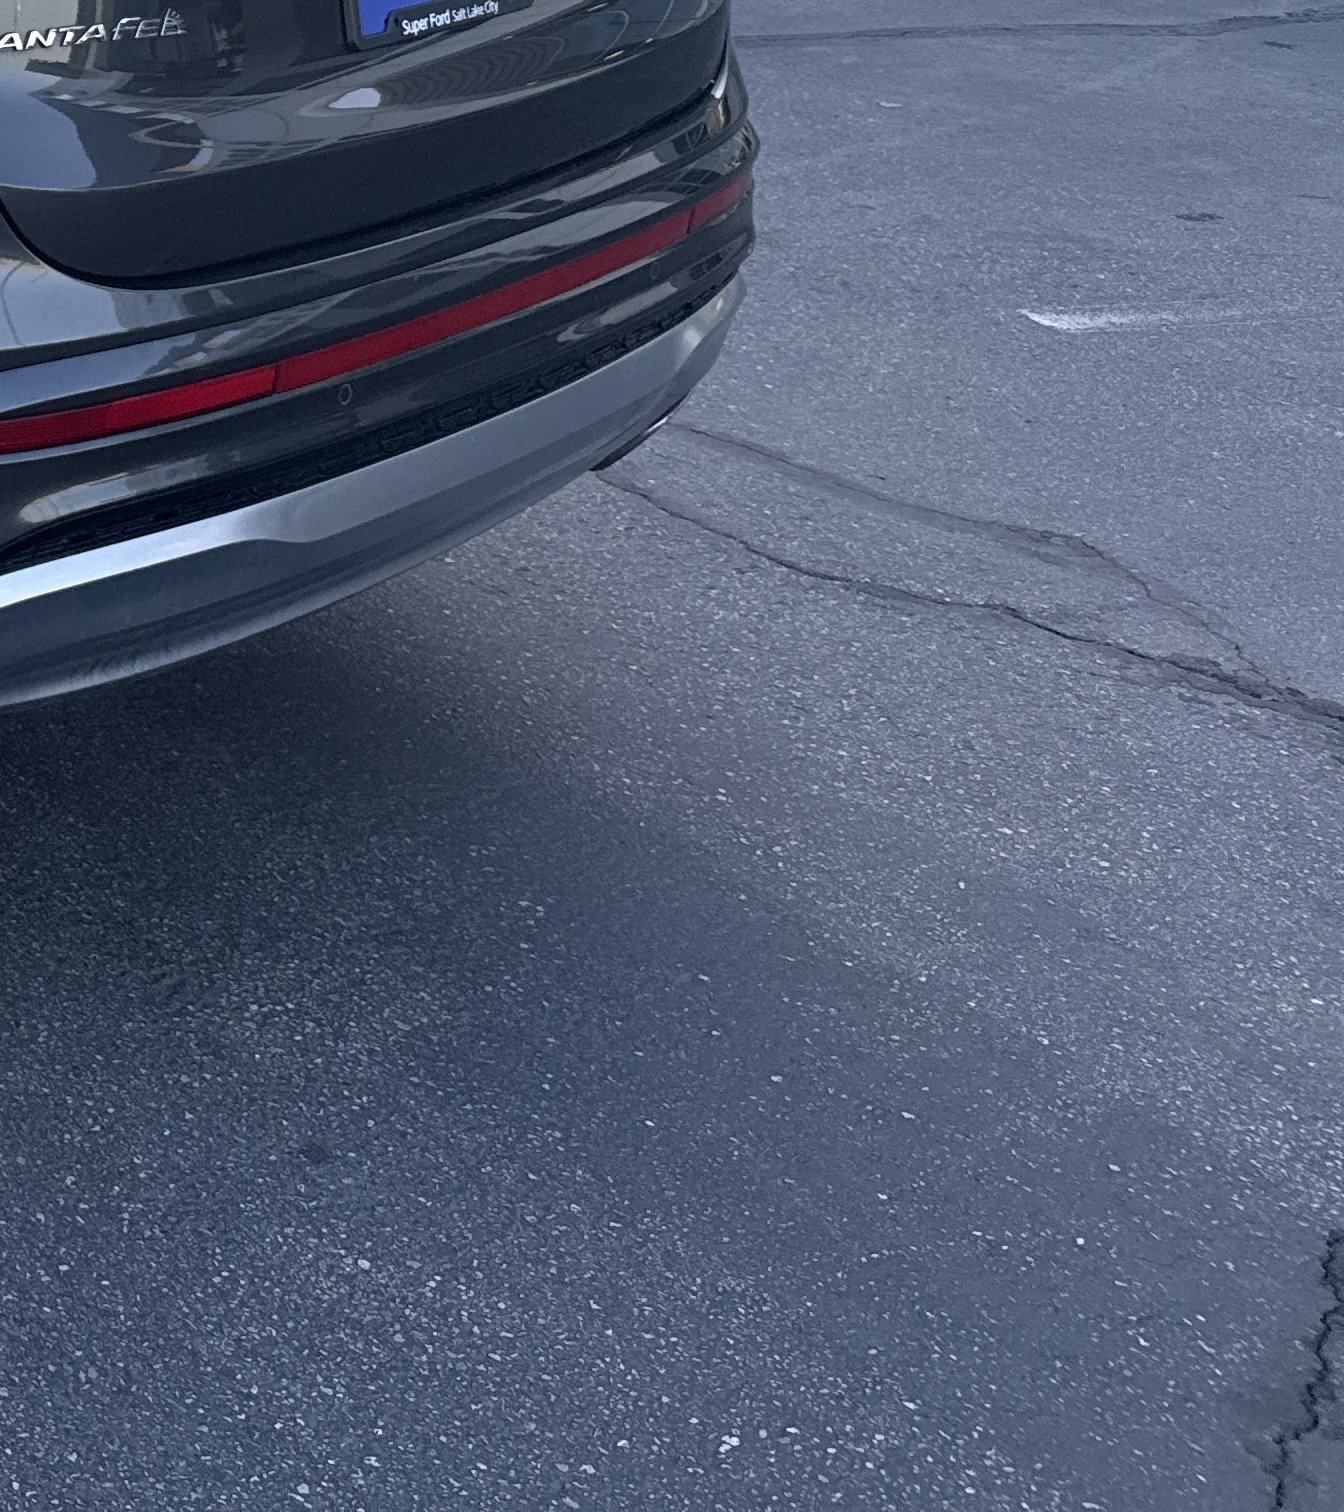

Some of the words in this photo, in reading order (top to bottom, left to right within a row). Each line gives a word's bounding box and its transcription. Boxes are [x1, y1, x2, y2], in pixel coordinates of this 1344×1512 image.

[402, 17, 429, 36] Super
[430, 9, 451, 27] Ford
[452, 6, 467, 21] Salt
[467, 4, 484, 18] Lake
[484, 0, 499, 15] City
